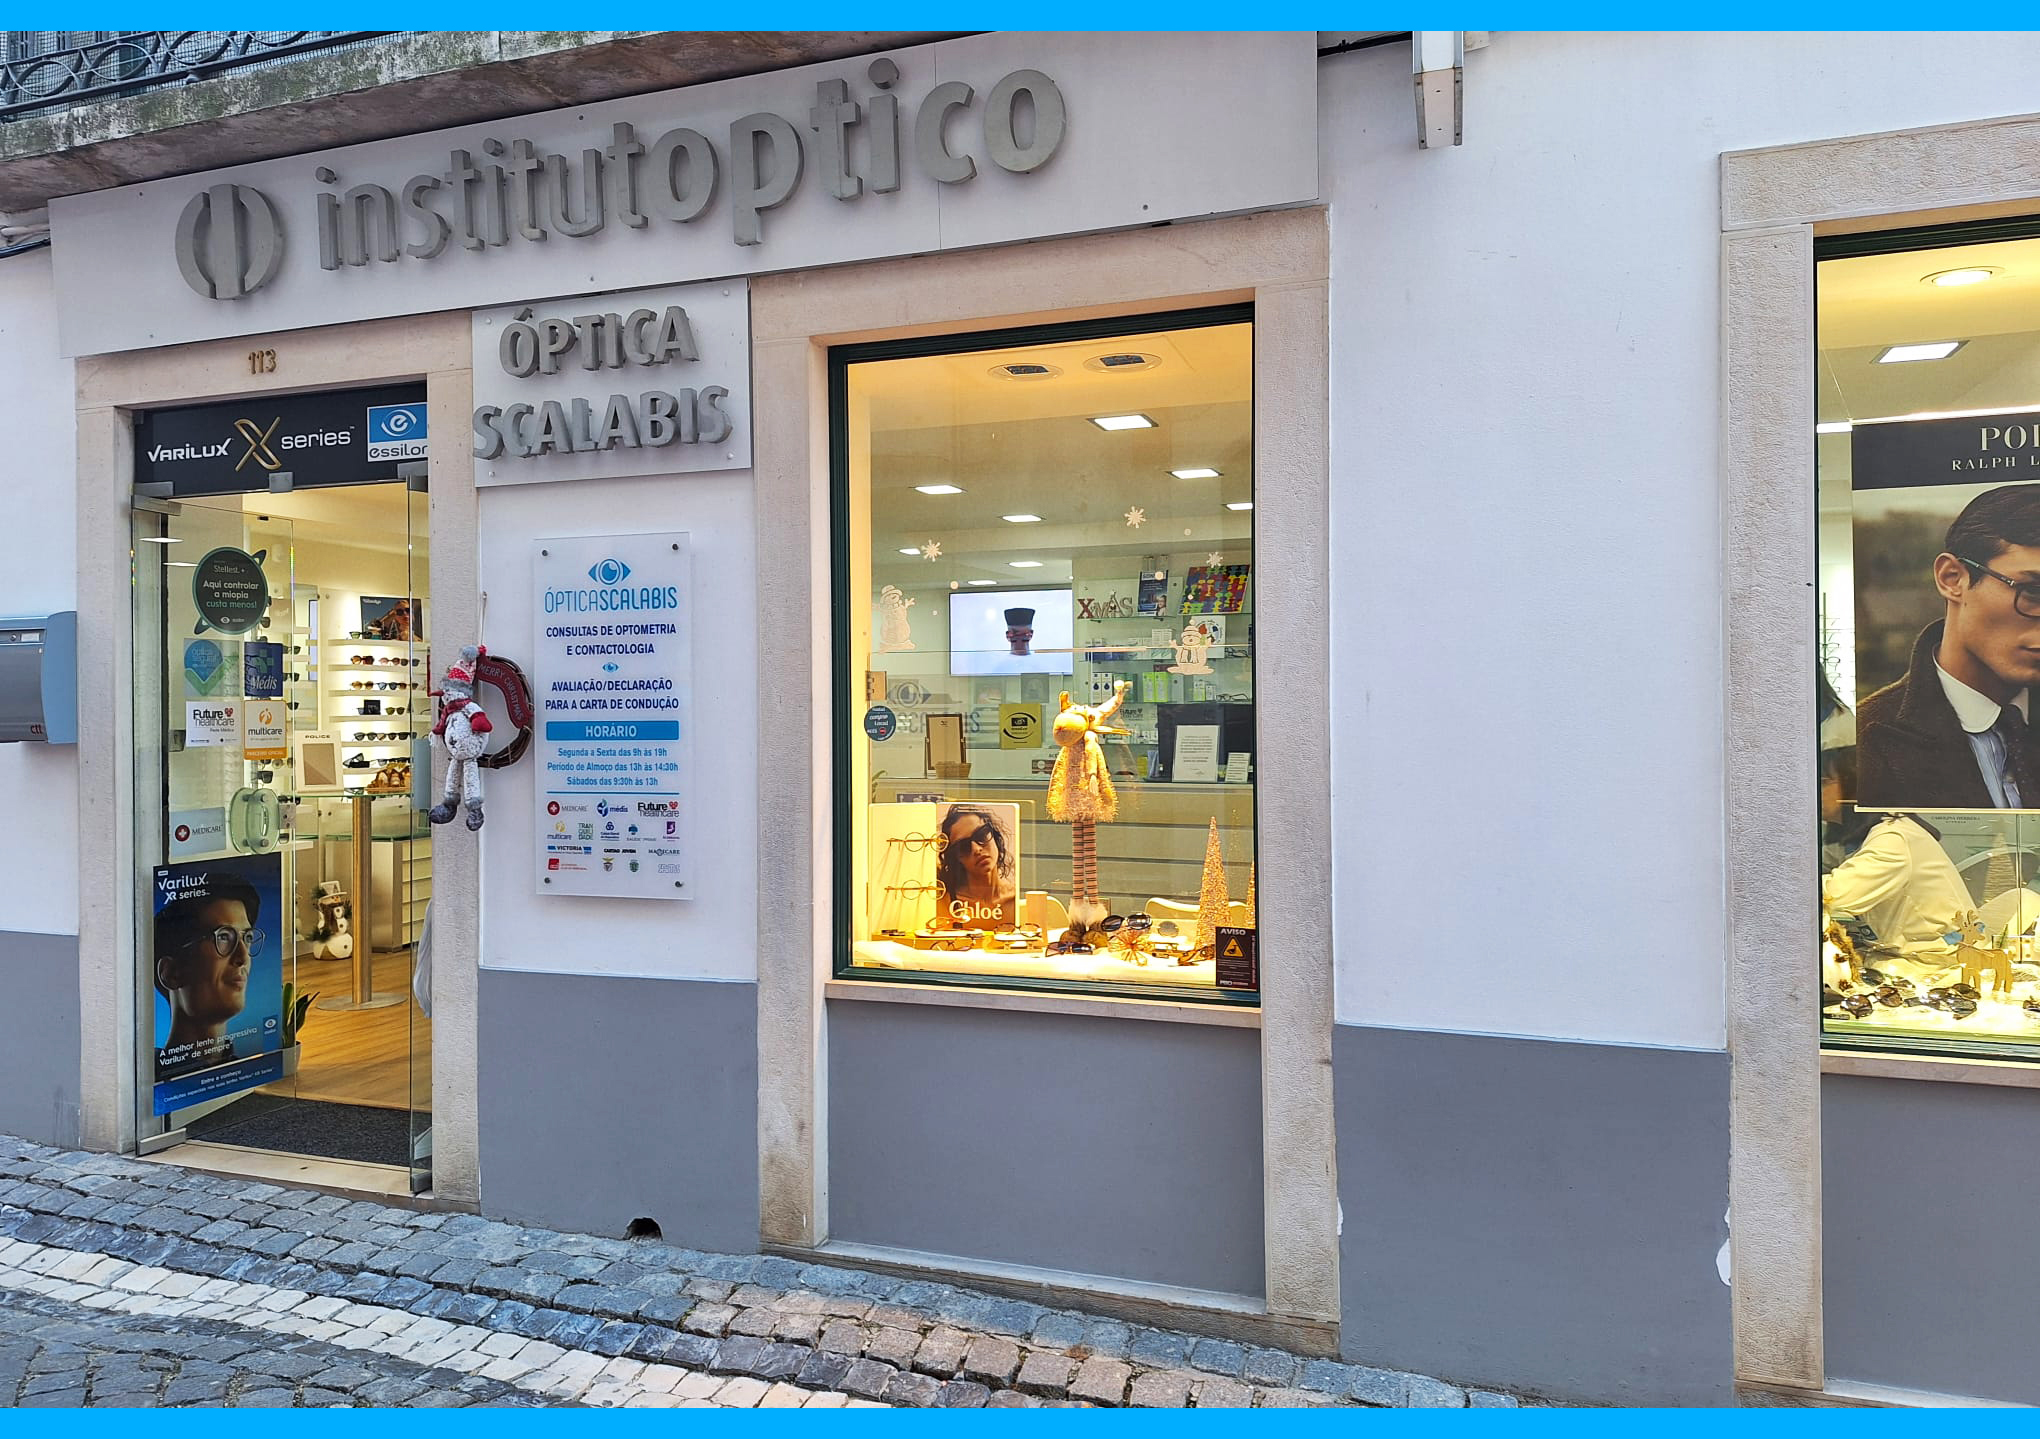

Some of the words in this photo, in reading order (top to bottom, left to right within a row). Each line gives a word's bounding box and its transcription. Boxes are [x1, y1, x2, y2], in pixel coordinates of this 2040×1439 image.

[315, 57, 1066, 270] institutoptico
[500, 305, 698, 378] ÓPTICA
[248, 349, 278, 376] 113
[472, 385, 732, 460] SCALABIS
[1952, 456, 2016, 470] RALPH
[203, 580, 221, 590] Aqui
[224, 581, 259, 590] controlar
[222, 591, 248, 600] miopia
[206, 600, 228, 608] custa
[229, 601, 257, 609] menos!
[546, 625, 598, 638] CONSULTAS
[600, 625, 613, 636] DE
[615, 623, 677, 636] OPTOMETRIA
[566, 645, 573, 655] E
[575, 643, 655, 655] CONTACTOLOGIA
[479, 664, 505, 678] MERRY
[504, 676, 525, 720] CHRISTMAS
[545, 699, 569, 710] PARA
[571, 699, 578, 709] A
[579, 698, 608, 710] CARTA
[610, 698, 623, 709] DE
[625, 695, 679, 711] CONDUÇÃO
[193, 708, 224, 720] Future
[248, 727, 283, 736] multicare
[585, 723, 637, 738] HORÁRIO
[558, 748, 589, 759] Segunda
[596, 748, 617, 756] Sexta
[618, 748, 632, 756] das
[632, 748, 641, 756] 9h
[654, 748, 667, 756] 19h
[547, 762, 574, 771] Período
[576, 763, 585, 771] de
[586, 762, 613, 773] Almoço
[614, 762, 627, 771] das
[628, 763, 642, 771] 13h
[654, 763, 678, 771] 14:30h
[567, 776, 598, 786] Sábados
[599, 777, 612, 785] das
[613, 777, 633, 786] 9:30h
[645, 777, 658, 786] 13h
[637, 802, 668, 812] Future
[192, 825, 222, 835] MEDICARE
[164, 891, 177, 904] XR
[949, 900, 1003, 920] Chloé
[168, 1043, 194, 1053] melhor
[197, 1038, 214, 1047] lente
[217, 1027, 257, 1043] progressiva
